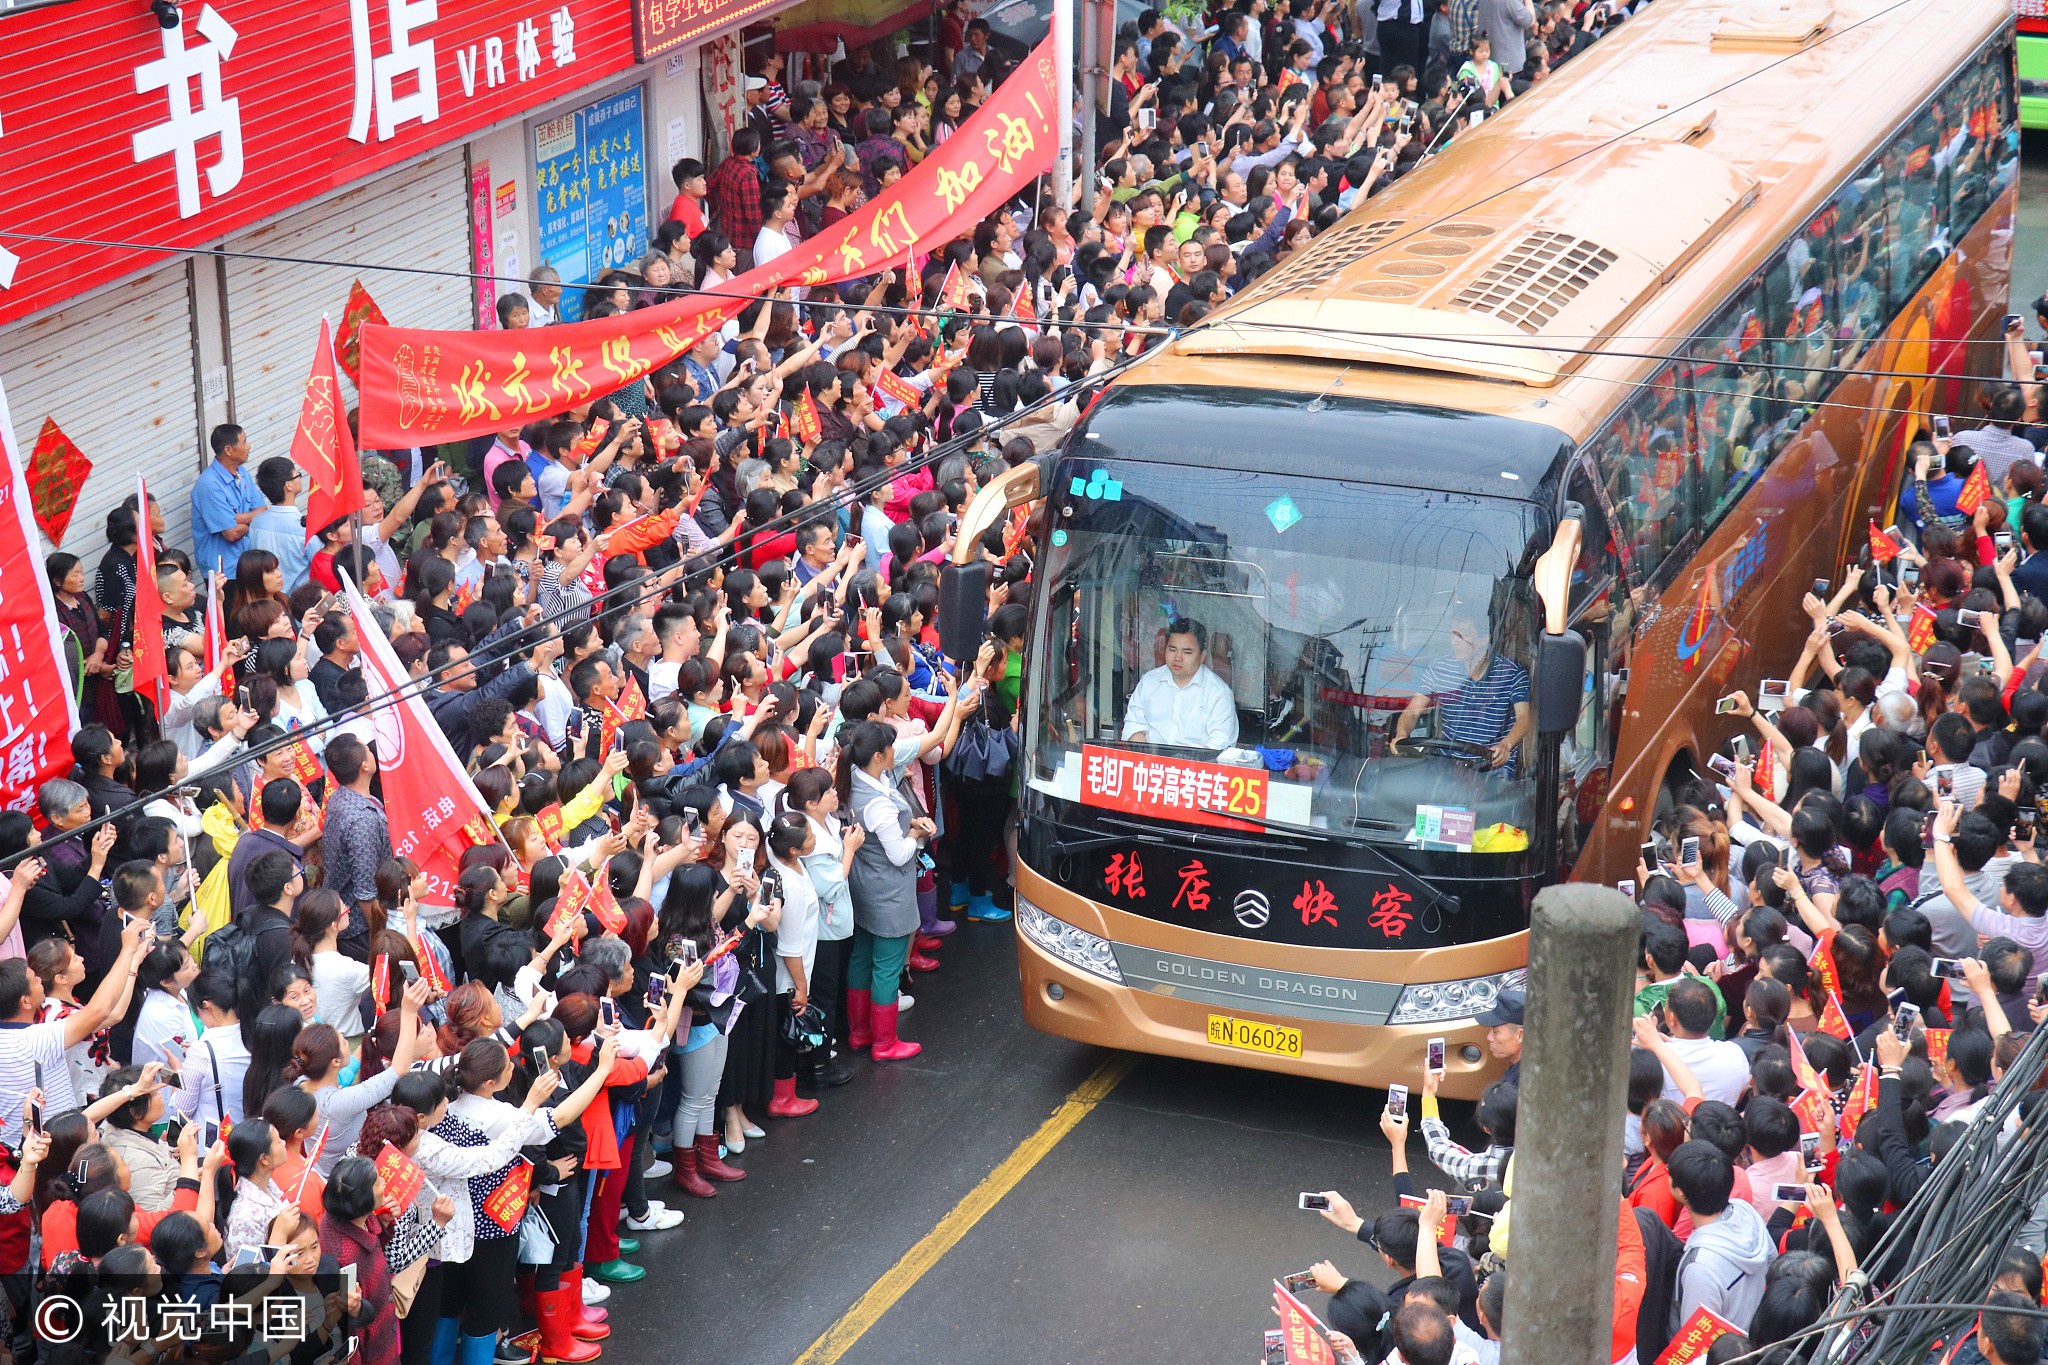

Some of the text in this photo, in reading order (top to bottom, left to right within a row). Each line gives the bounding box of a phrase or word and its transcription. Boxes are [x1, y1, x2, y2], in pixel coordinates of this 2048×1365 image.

[456, 6, 578, 99] VR体验
[589, 128, 632, 166] 改变人生
[536, 151, 582, 192] 提高一分
[598, 150, 641, 190] 免费接送
[546, 172, 591, 214] 免费试听
[1156, 960, 1358, 1001] GOLDEN DRAGON
